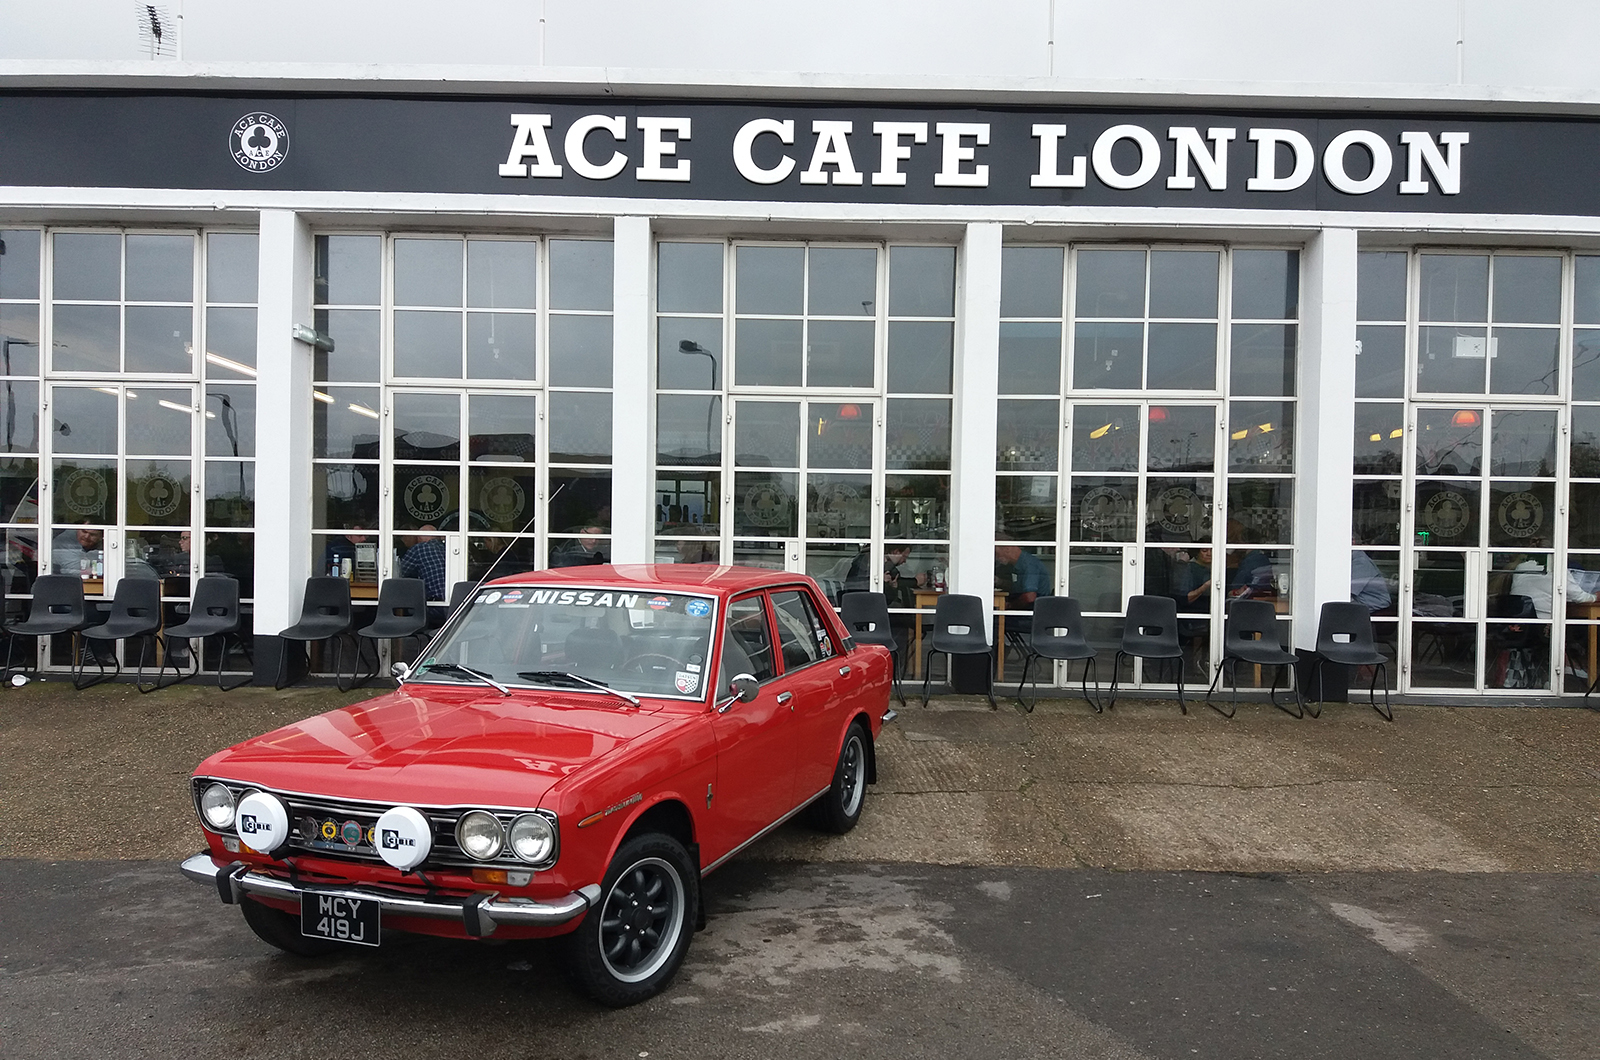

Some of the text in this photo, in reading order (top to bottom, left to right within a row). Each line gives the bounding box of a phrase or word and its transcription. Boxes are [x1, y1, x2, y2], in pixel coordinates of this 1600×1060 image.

[234, 115, 286, 139] ACE CAFE
[234, 149, 283, 170] LONDON
[498, 113, 1470, 195] ACE CAFE LONDON
[407, 475, 446, 492] ACE CAFE
[68, 500, 104, 515] LONDON
[141, 501, 177, 515] LONDON
[1427, 492, 1468, 510] ACE CAFE
[1501, 492, 1541, 510] ACE CAFE
[409, 505, 446, 520] LONDON
[485, 507, 521, 522] LONDON
[1429, 522, 1466, 537] LONDON
[1502, 522, 1539, 537] LONDON
[528, 590, 639, 608] NISSAN
[319, 895, 362, 919] MCY
[316, 916, 364, 941] 419J
